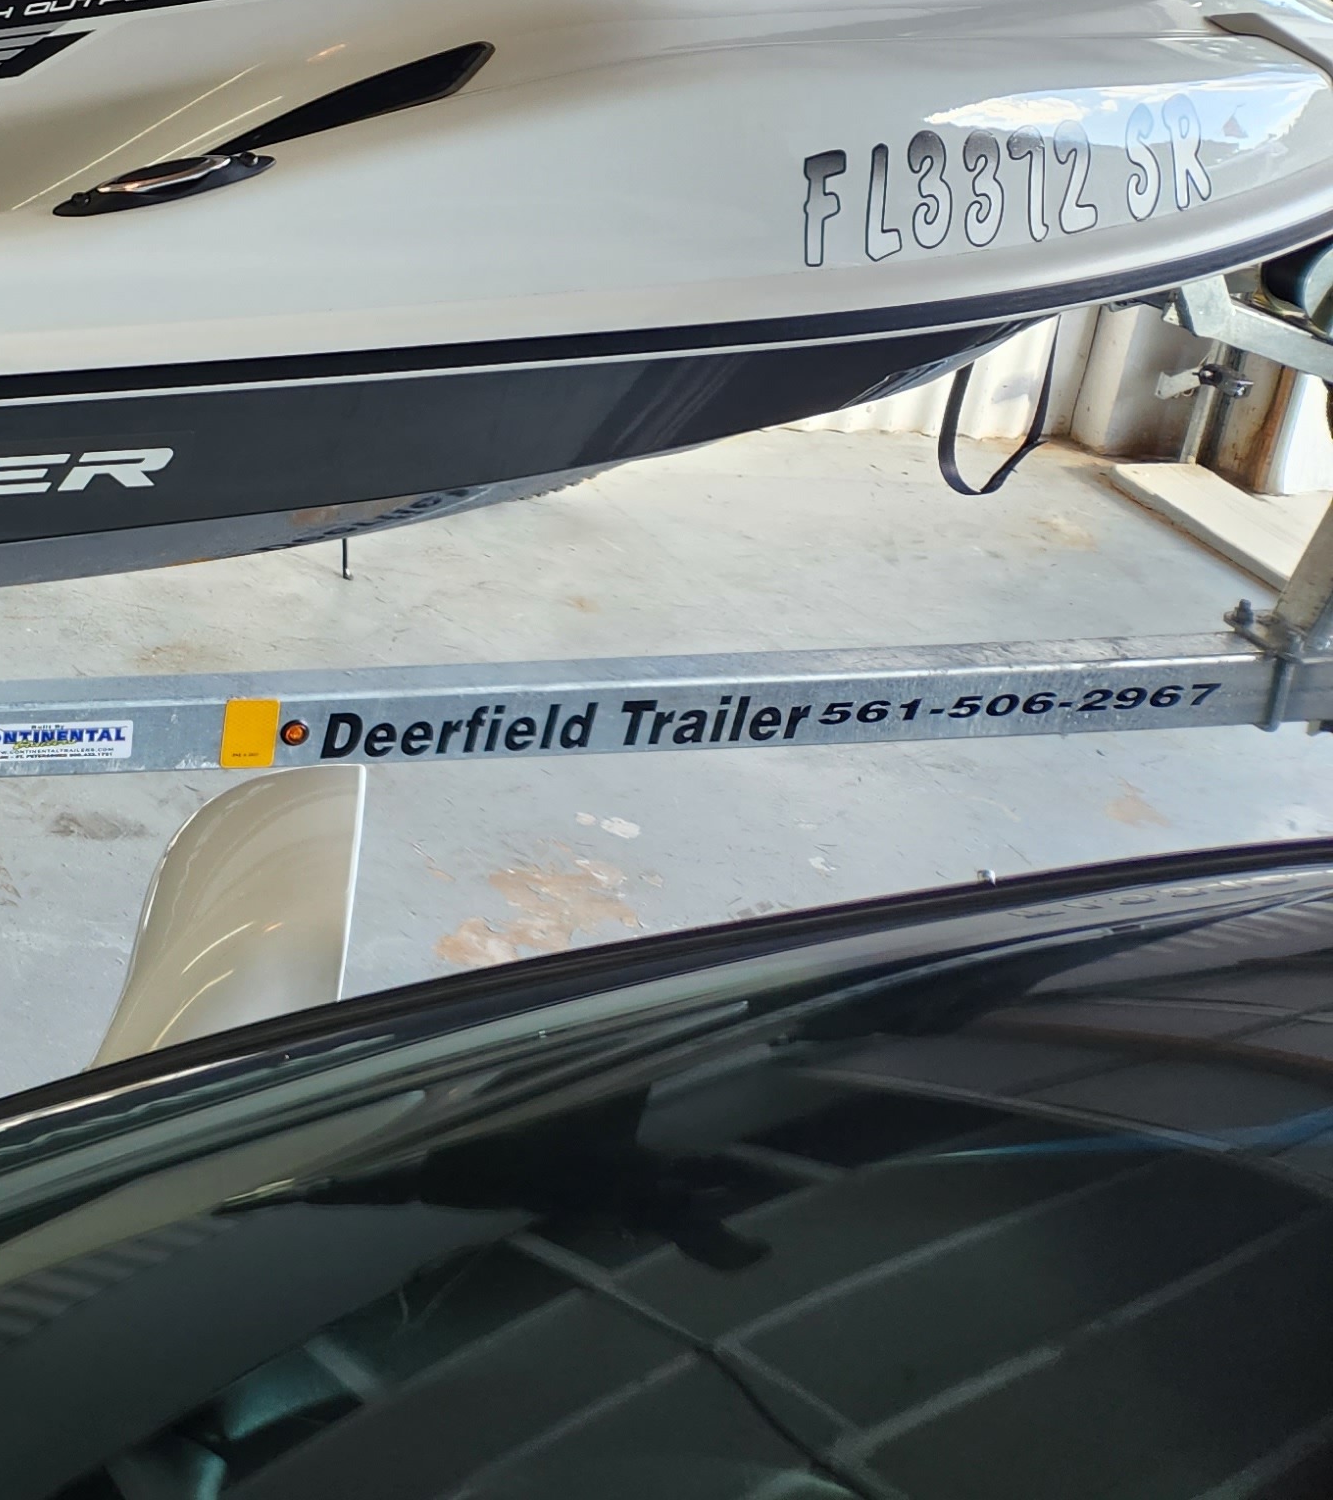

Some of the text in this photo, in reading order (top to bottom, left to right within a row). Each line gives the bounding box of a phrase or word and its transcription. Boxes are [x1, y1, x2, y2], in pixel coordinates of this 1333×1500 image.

[1124, 93, 1213, 222] SR
[320, 682, 1222, 760] Deerfield Trailer 561-506-2967
